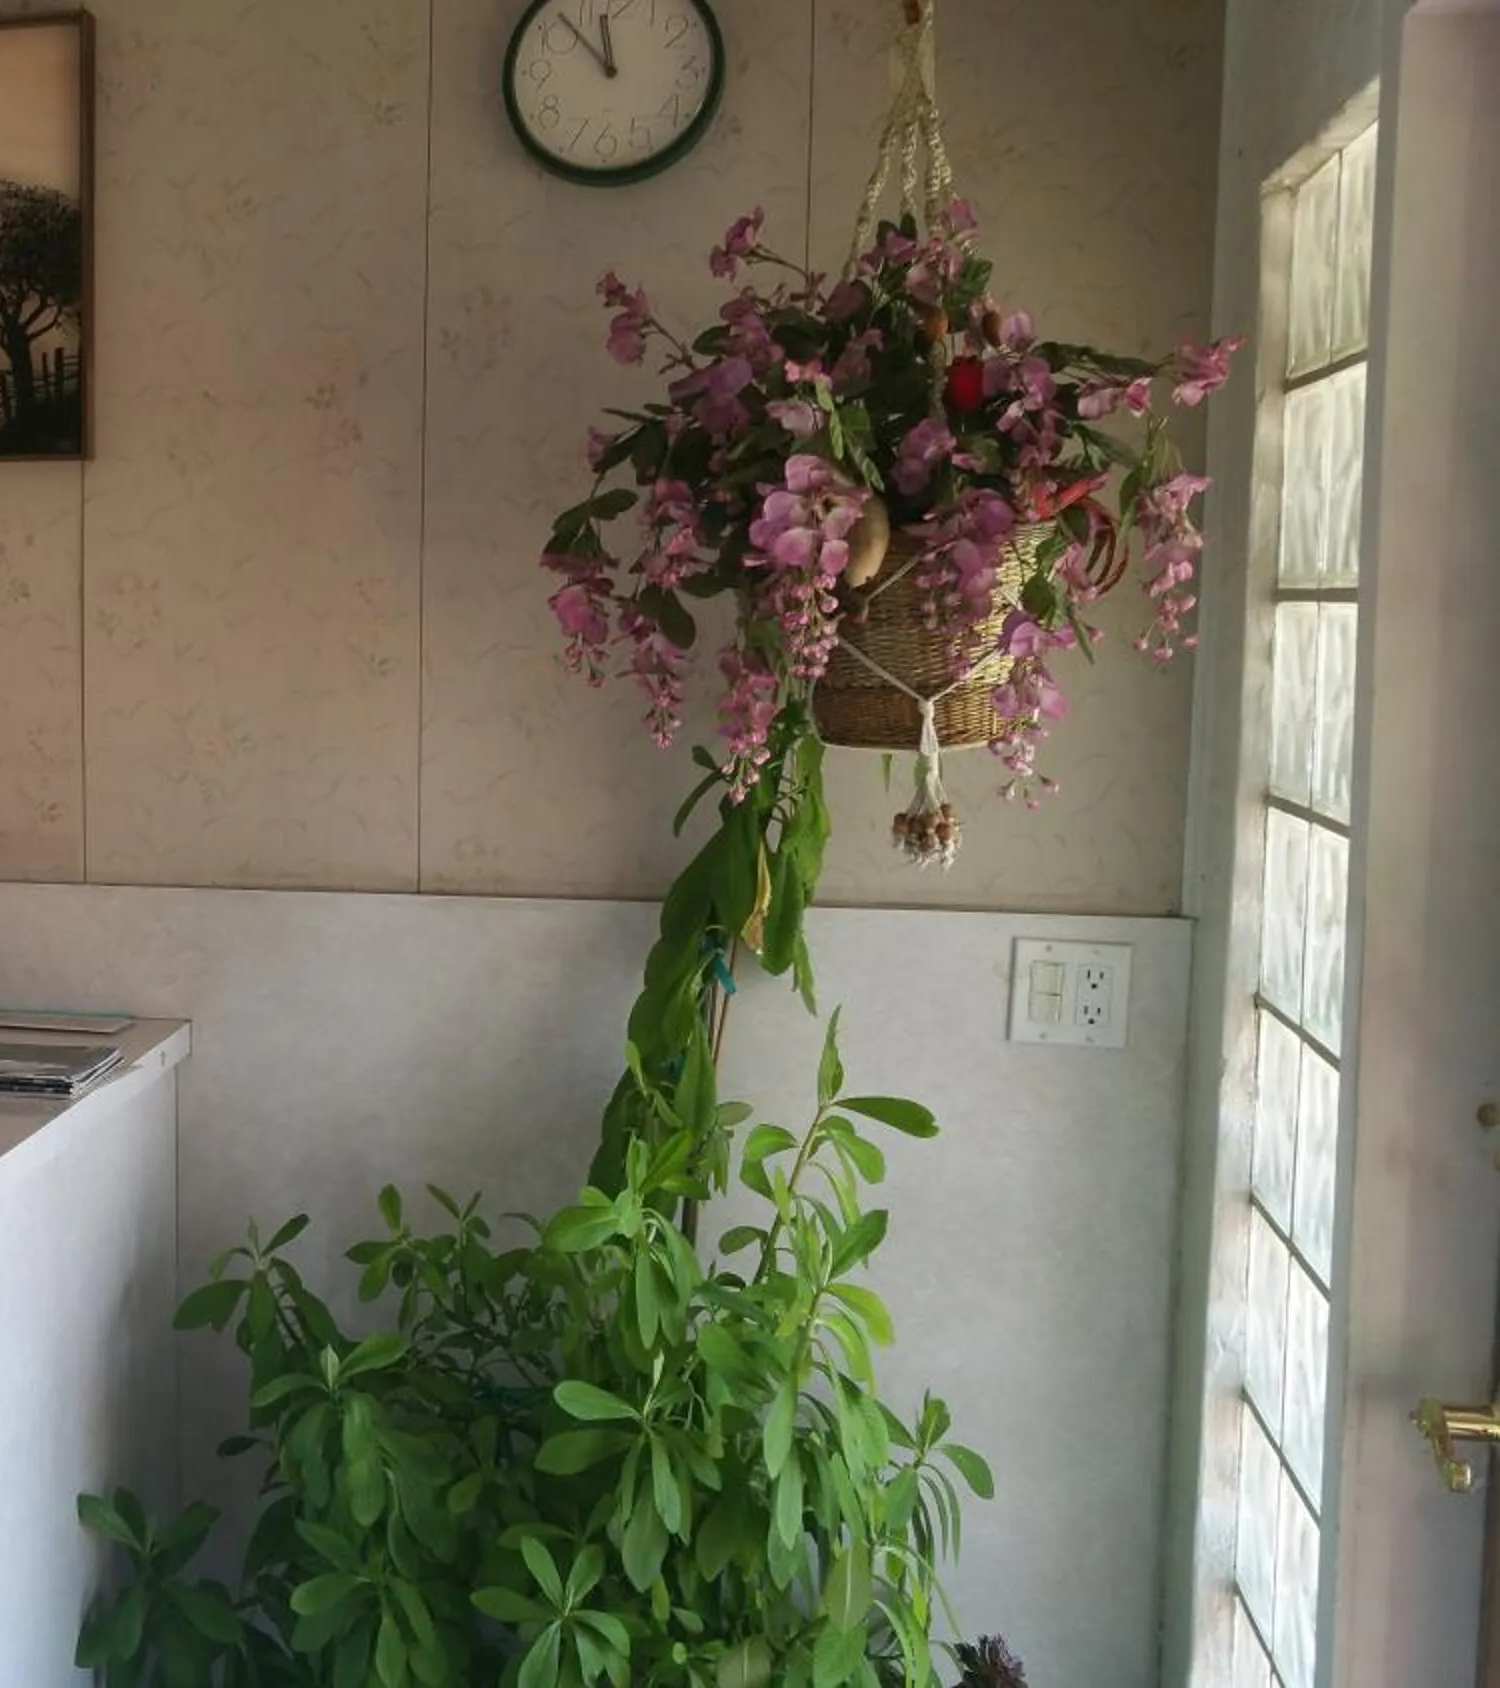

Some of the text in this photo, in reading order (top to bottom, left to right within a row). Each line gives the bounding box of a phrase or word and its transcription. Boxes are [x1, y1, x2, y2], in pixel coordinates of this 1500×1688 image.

[541, 18, 579, 55] 10
[664, 14, 689, 49] 2
[529, 59, 551, 92] 9
[674, 54, 699, 88] 3
[537, 93, 560, 130] 8
[657, 93, 680, 129] 4
[594, 126, 617, 157] 6
